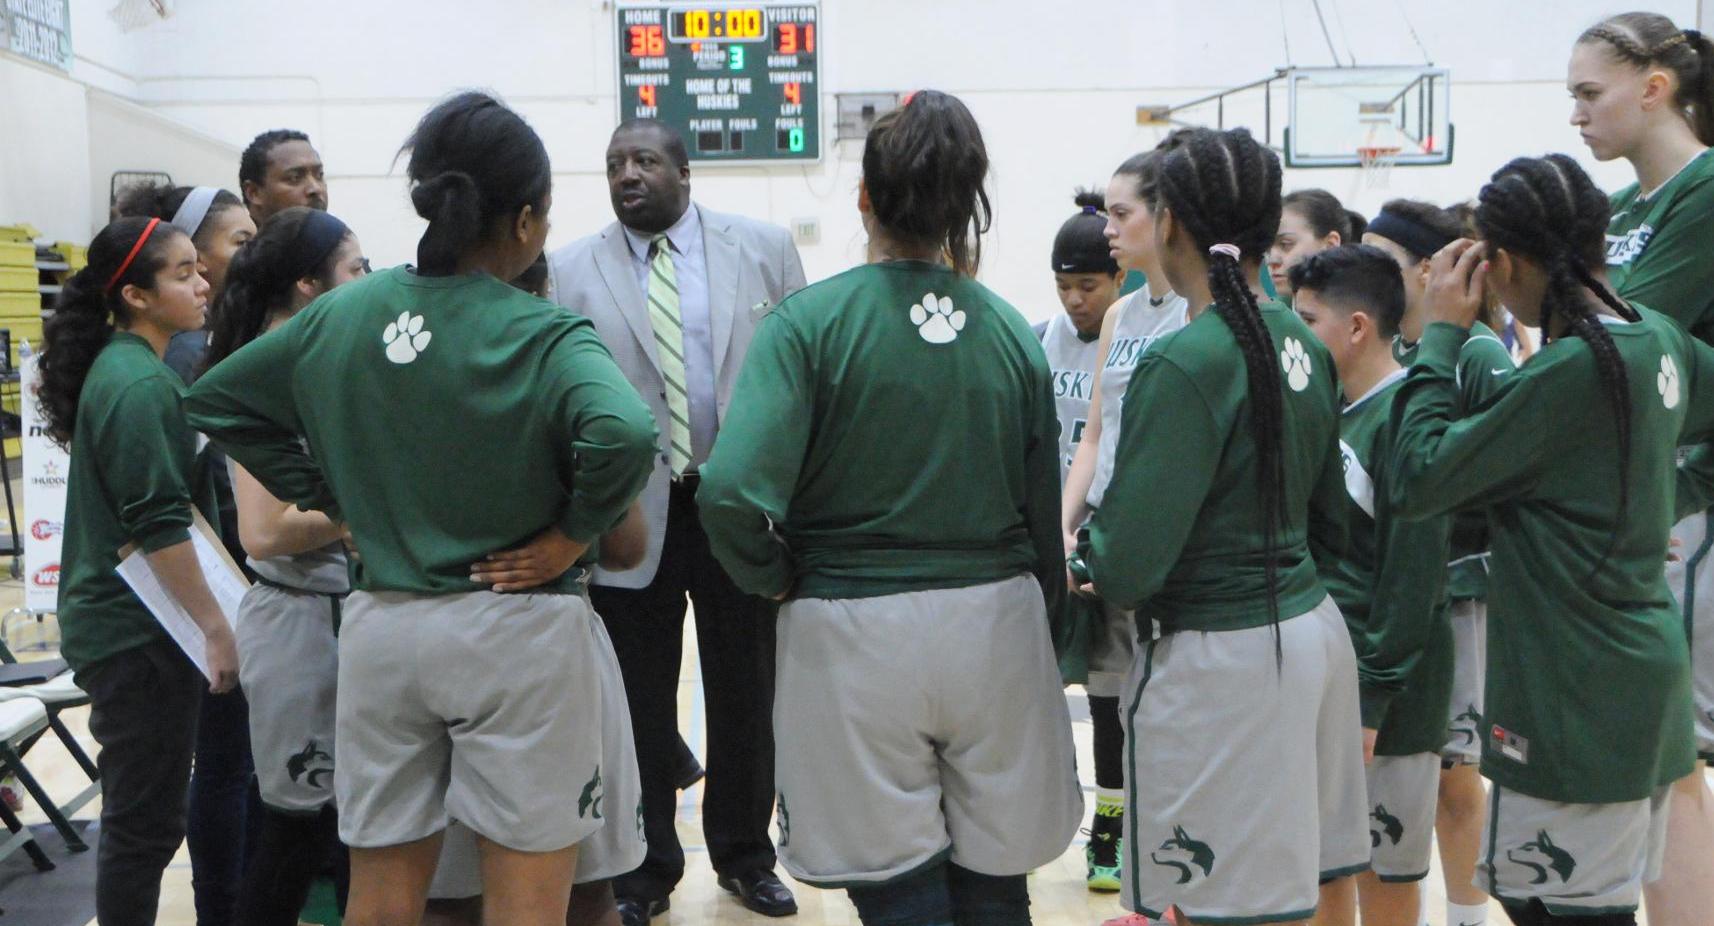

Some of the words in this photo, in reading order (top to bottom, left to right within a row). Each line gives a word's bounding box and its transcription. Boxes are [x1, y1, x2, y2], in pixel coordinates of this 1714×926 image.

[625, 9, 661, 24] HOME
[768, 8, 815, 22] VISITOR
[685, 9, 761, 38] 10:00
[630, 25, 665, 57] 36
[779, 23, 814, 54] 31
[639, 57, 669, 69] BONUS
[729, 45, 744, 70] 3
[767, 56, 798, 68] BONUS
[624, 74, 669, 86] TIMEOUTS
[768, 71, 813, 84] TIMEOUTS
[686, 79, 715, 94] HOME
[716, 79, 730, 94] OF
[731, 78, 751, 94] THE
[783, 82, 800, 105] 4
[639, 85, 656, 107] 4
[697, 94, 740, 110] HUSKIES
[689, 119, 723, 131] PLAYER
[729, 118, 757, 131] FOULS
[775, 117, 804, 130] FOULS
[789, 128, 804, 152] 0
